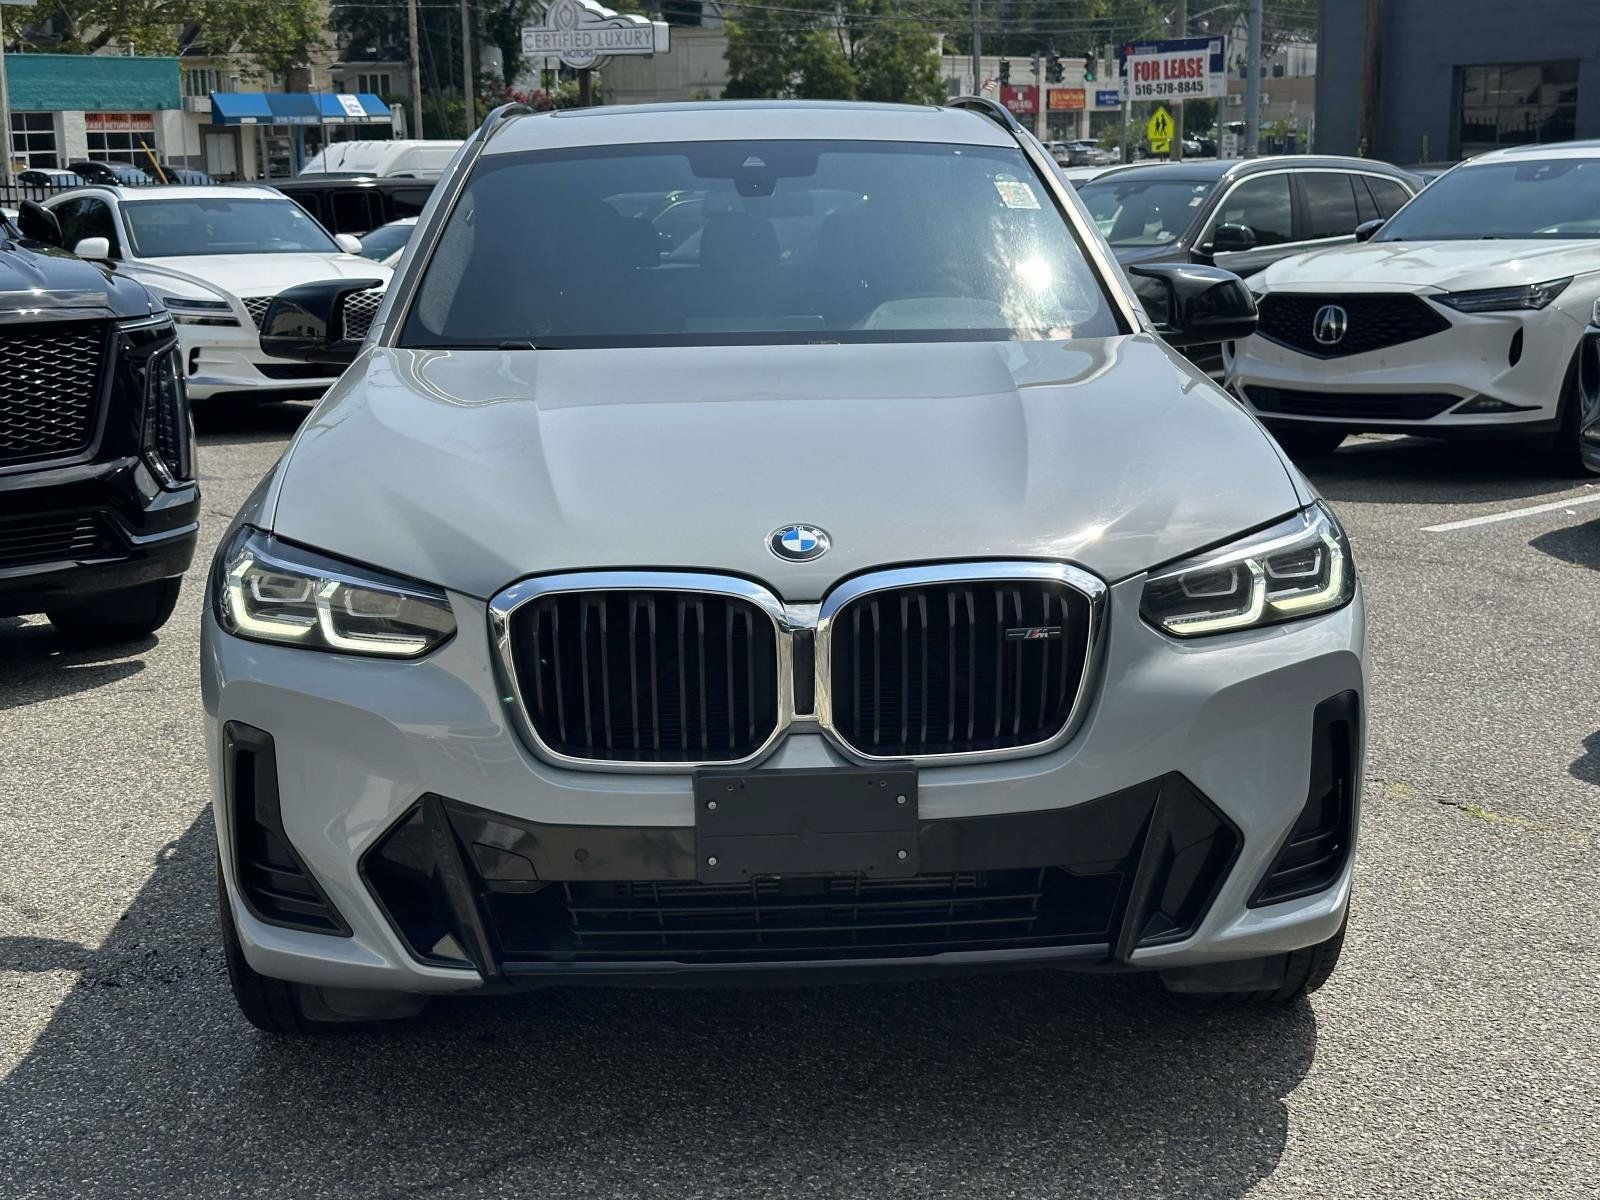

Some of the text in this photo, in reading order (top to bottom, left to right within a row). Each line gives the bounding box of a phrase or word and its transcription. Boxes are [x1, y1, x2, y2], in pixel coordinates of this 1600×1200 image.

[523, 29, 652, 49] CERTIFIED LUXURY
[562, 48, 595, 58] MOTORS
[1133, 57, 1204, 82] FOR LEASE
[1135, 80, 1204, 96] 516-578-8845
